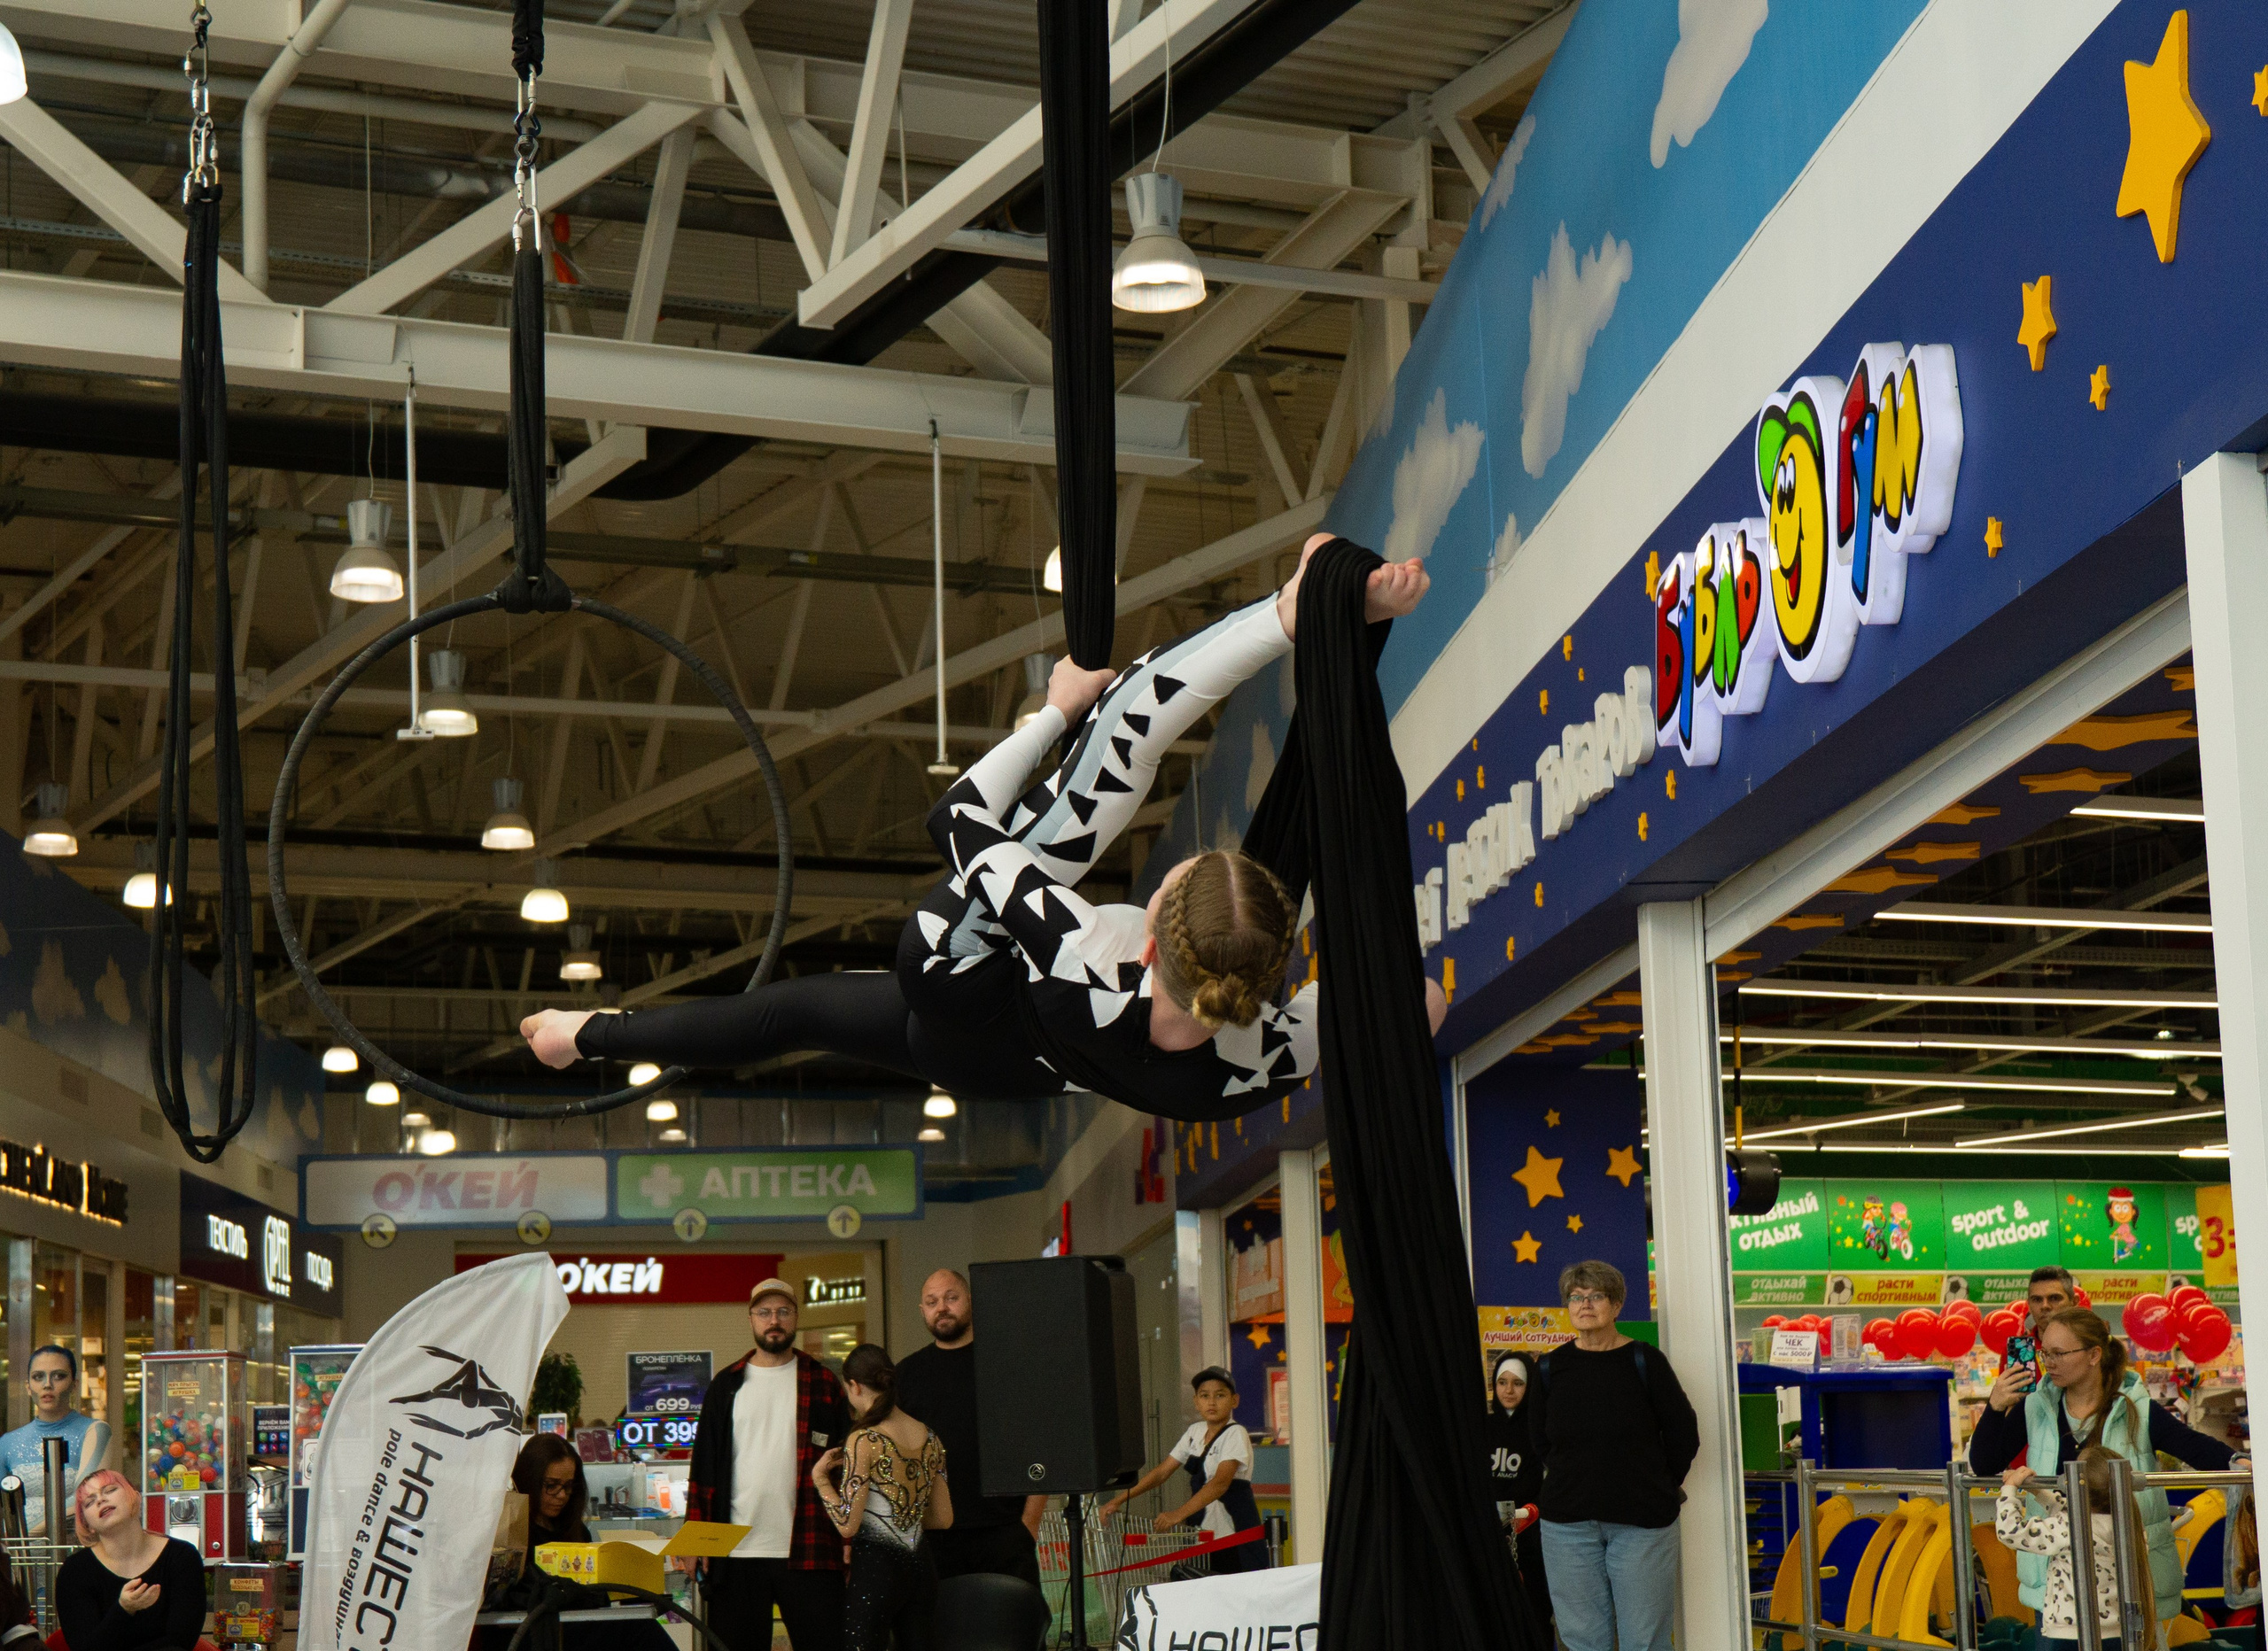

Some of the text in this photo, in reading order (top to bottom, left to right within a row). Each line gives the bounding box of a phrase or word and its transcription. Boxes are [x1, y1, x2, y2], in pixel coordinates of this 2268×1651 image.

[700, 1163, 877, 1198] АПТЕКА
[1951, 1199, 2030, 1236] sport &
[207, 1213, 249, 1260] ТЕКСТИЛЬ
[1971, 1218, 2050, 1251] outdoor
[1856, 1291, 1937, 1305] спортивным
[1876, 1278, 1914, 1291] расти
[635, 1354, 703, 1364] БРОНЕПЛЁНКА
[656, 1397, 690, 1412] 699
[623, 1422, 658, 1444] ОТ
[335, 1427, 402, 1651] pole dance & воздушн
[348, 1441, 443, 1651] НАШЕС
